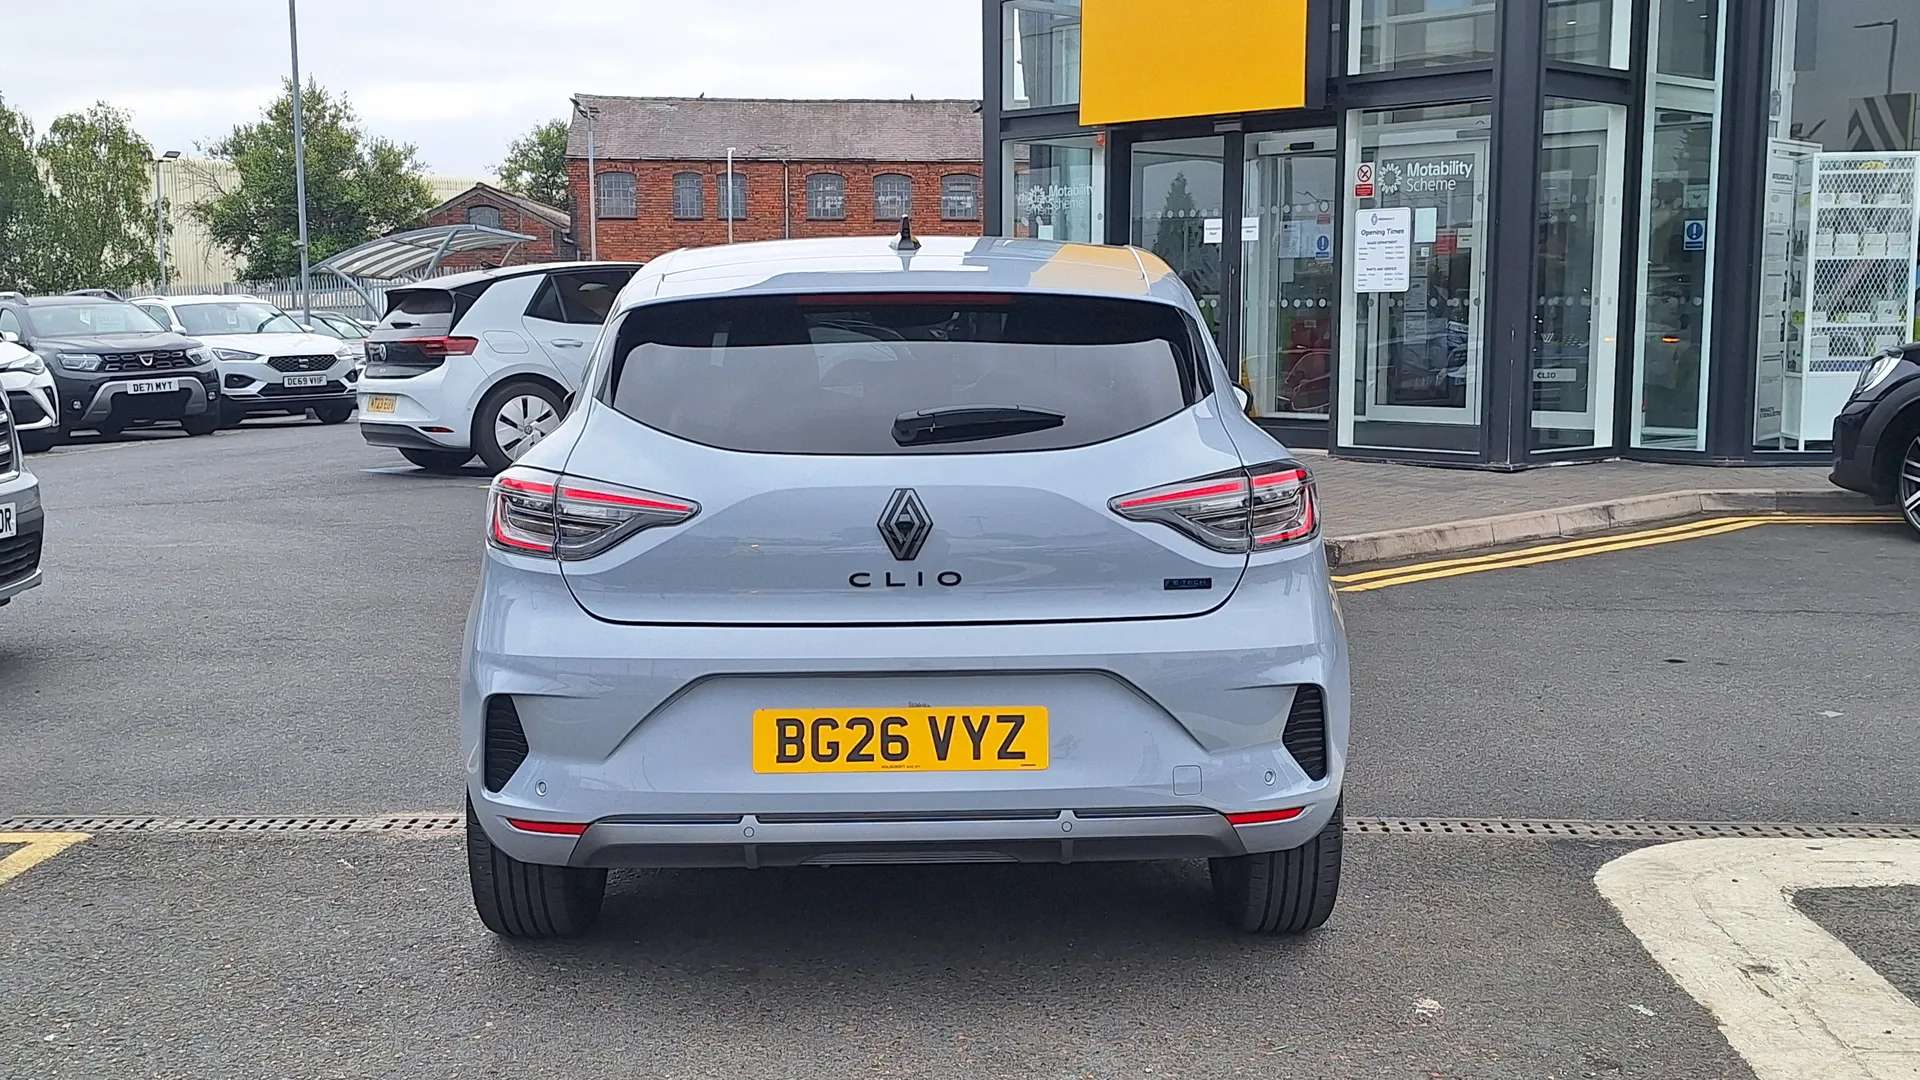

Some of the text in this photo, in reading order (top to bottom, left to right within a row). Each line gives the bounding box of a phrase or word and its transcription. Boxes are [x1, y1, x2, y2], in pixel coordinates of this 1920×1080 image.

[1406, 160, 1473, 178] Motability
[1406, 178, 1457, 192] Scheme
[1361, 227, 1405, 237] Opening Times
[1536, 371, 1557, 379] CLIO
[287, 377, 308, 386] DE69
[133, 383, 154, 393] DE71
[848, 571, 962, 588] CLIO
[775, 714, 1026, 763] BG26 VYZ
